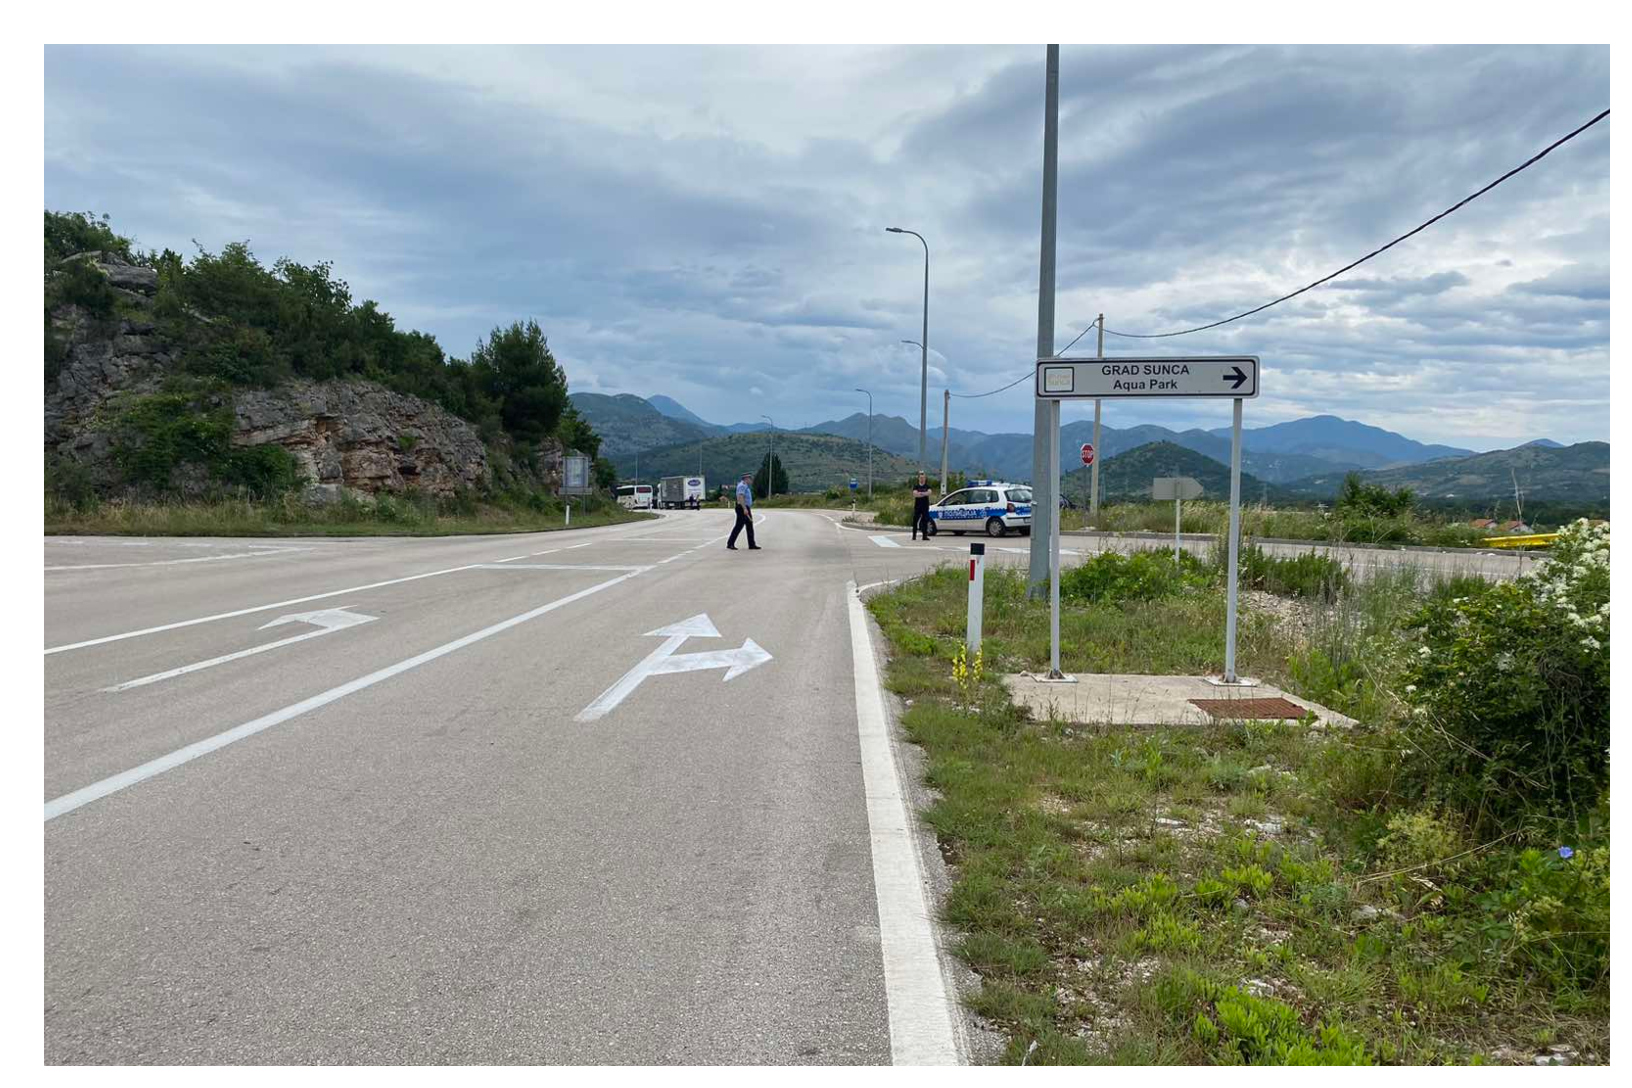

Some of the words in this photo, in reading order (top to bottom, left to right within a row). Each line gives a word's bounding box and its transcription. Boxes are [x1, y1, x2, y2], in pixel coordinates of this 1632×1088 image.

[1101, 365, 1140, 376] GRAD
[1143, 364, 1190, 376] SUNCA
[1113, 380, 1146, 392] Aqua
[1149, 379, 1178, 390] Park
